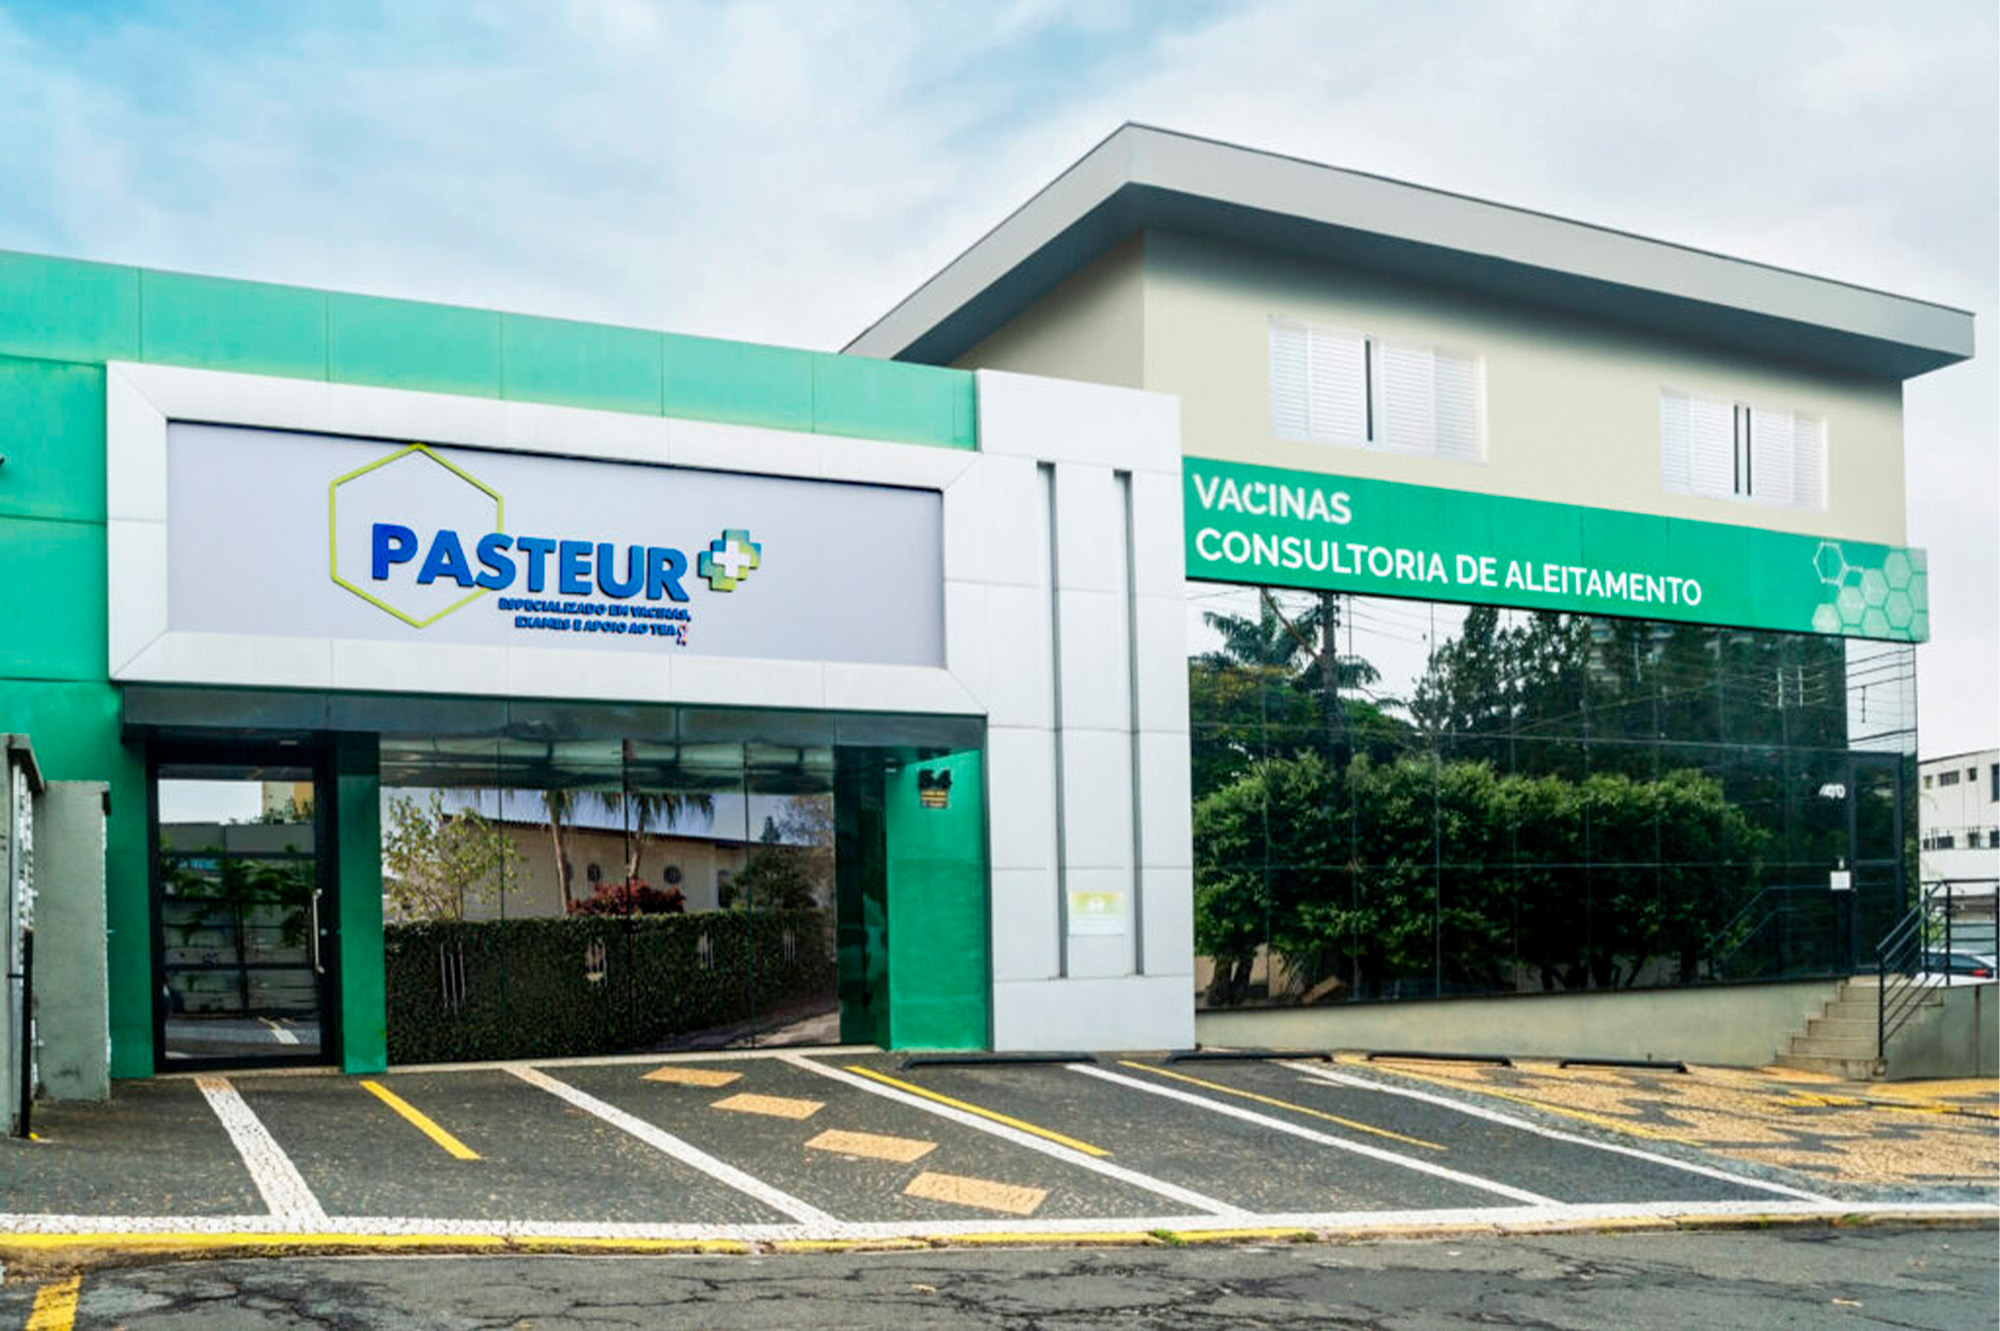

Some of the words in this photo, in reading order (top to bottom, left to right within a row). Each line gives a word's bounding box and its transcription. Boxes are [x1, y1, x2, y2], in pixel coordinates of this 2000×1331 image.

[1193, 474, 1352, 525] VACINAS
[372, 522, 691, 604] PASTEUR
[1195, 527, 1449, 584] CONSULTORIA
[1455, 555, 1498, 587] DE
[1505, 560, 1702, 606] ALEITAMENTO
[498, 597, 607, 616] ESPECIALIZADO
[608, 604, 629, 617] EM
[515, 615, 571, 631] EXAMES
[572, 619, 582, 632] E
[583, 620, 628, 634] APOIO
[628, 622, 649, 635] AO
[650, 623, 677, 636] TEA
